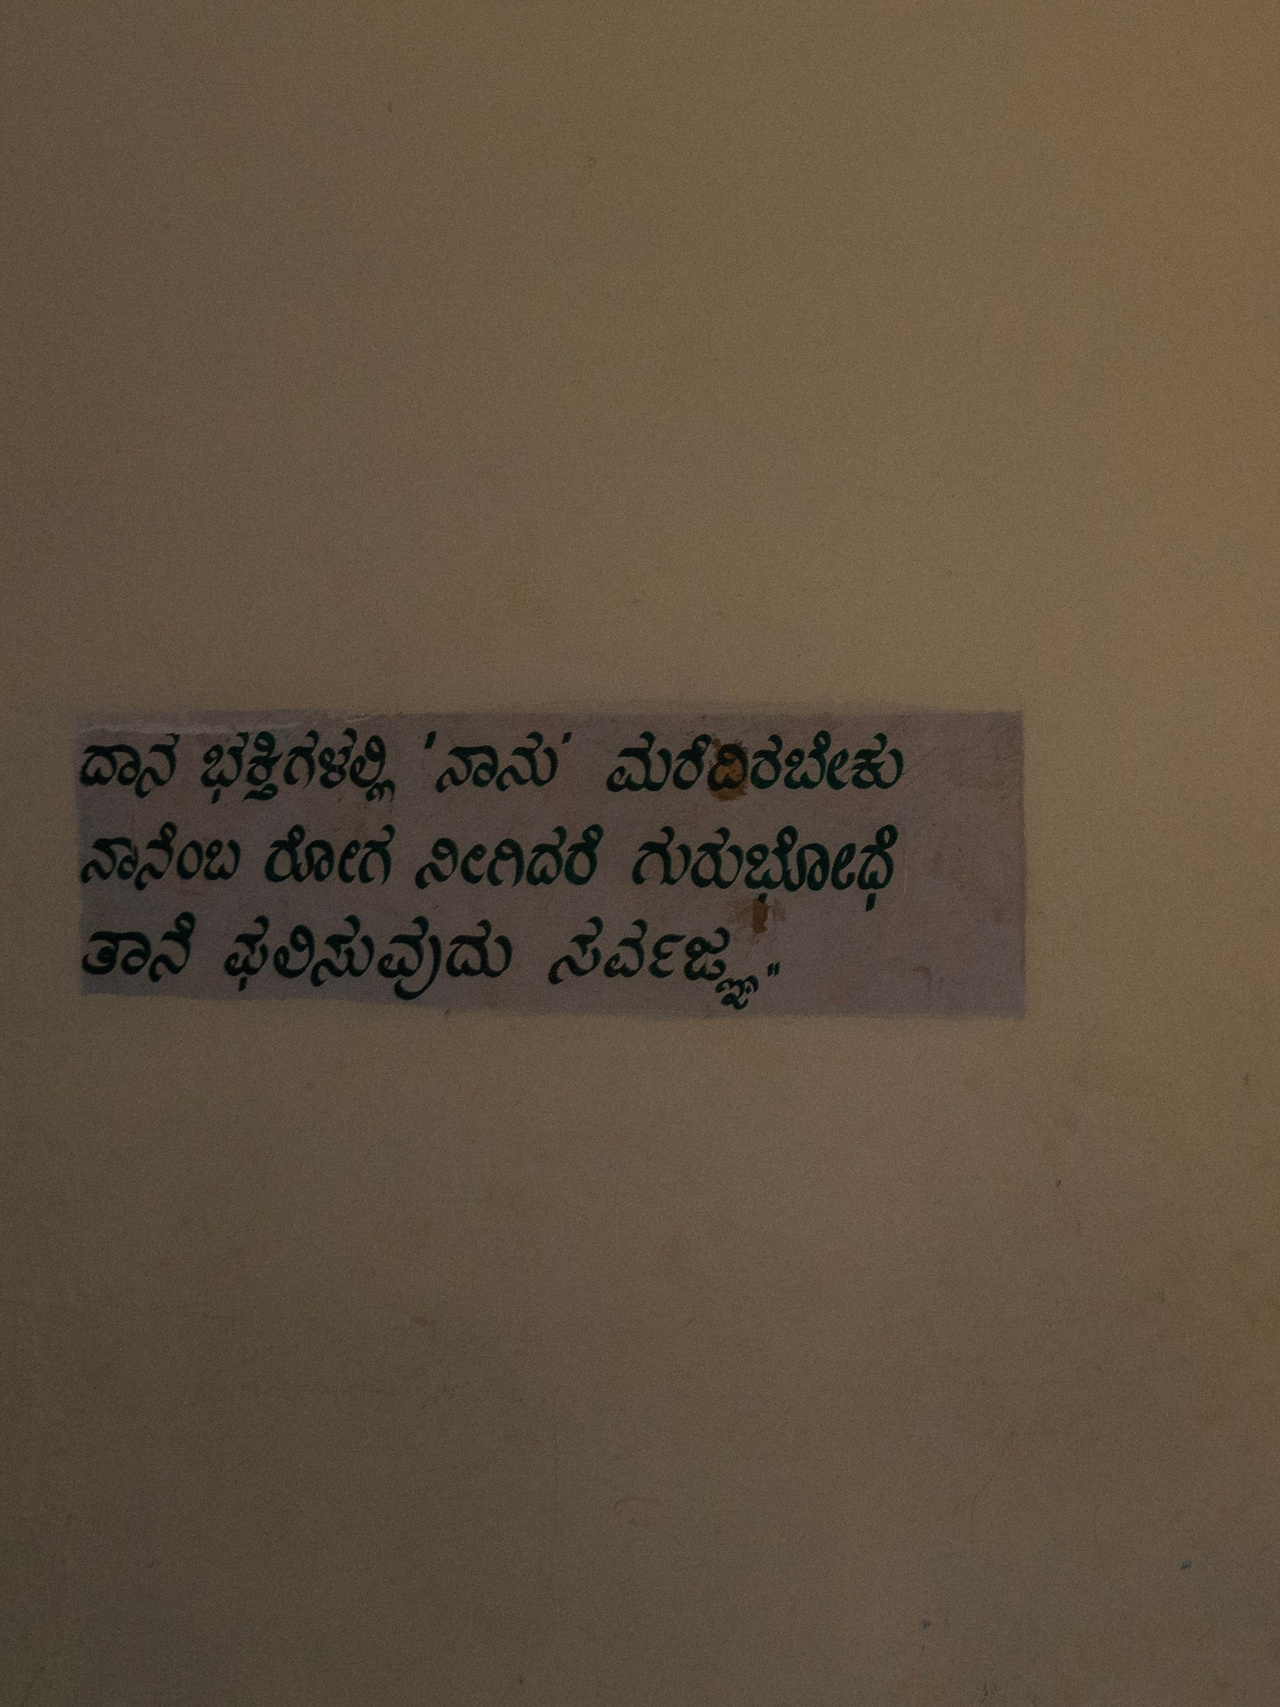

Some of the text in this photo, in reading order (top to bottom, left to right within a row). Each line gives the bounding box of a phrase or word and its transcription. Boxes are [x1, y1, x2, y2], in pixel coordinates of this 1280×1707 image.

[79, 732, 181, 798] ದಾನ
[200, 727, 396, 805] ಭಕ್ತಿಗಳಲ್ಲಿ
[605, 729, 905, 792] ಮರೆದಿರಬೇಕು
[79, 821, 900, 913] ನಾನೆಂಬ ರೋಗ ನೀಗಿದರೆ ಗುರುಭೋಧೆ
[80, 911, 197, 983] ತಾನೆ
[223, 914, 514, 1002] ಫಲಿಸುವುದು
